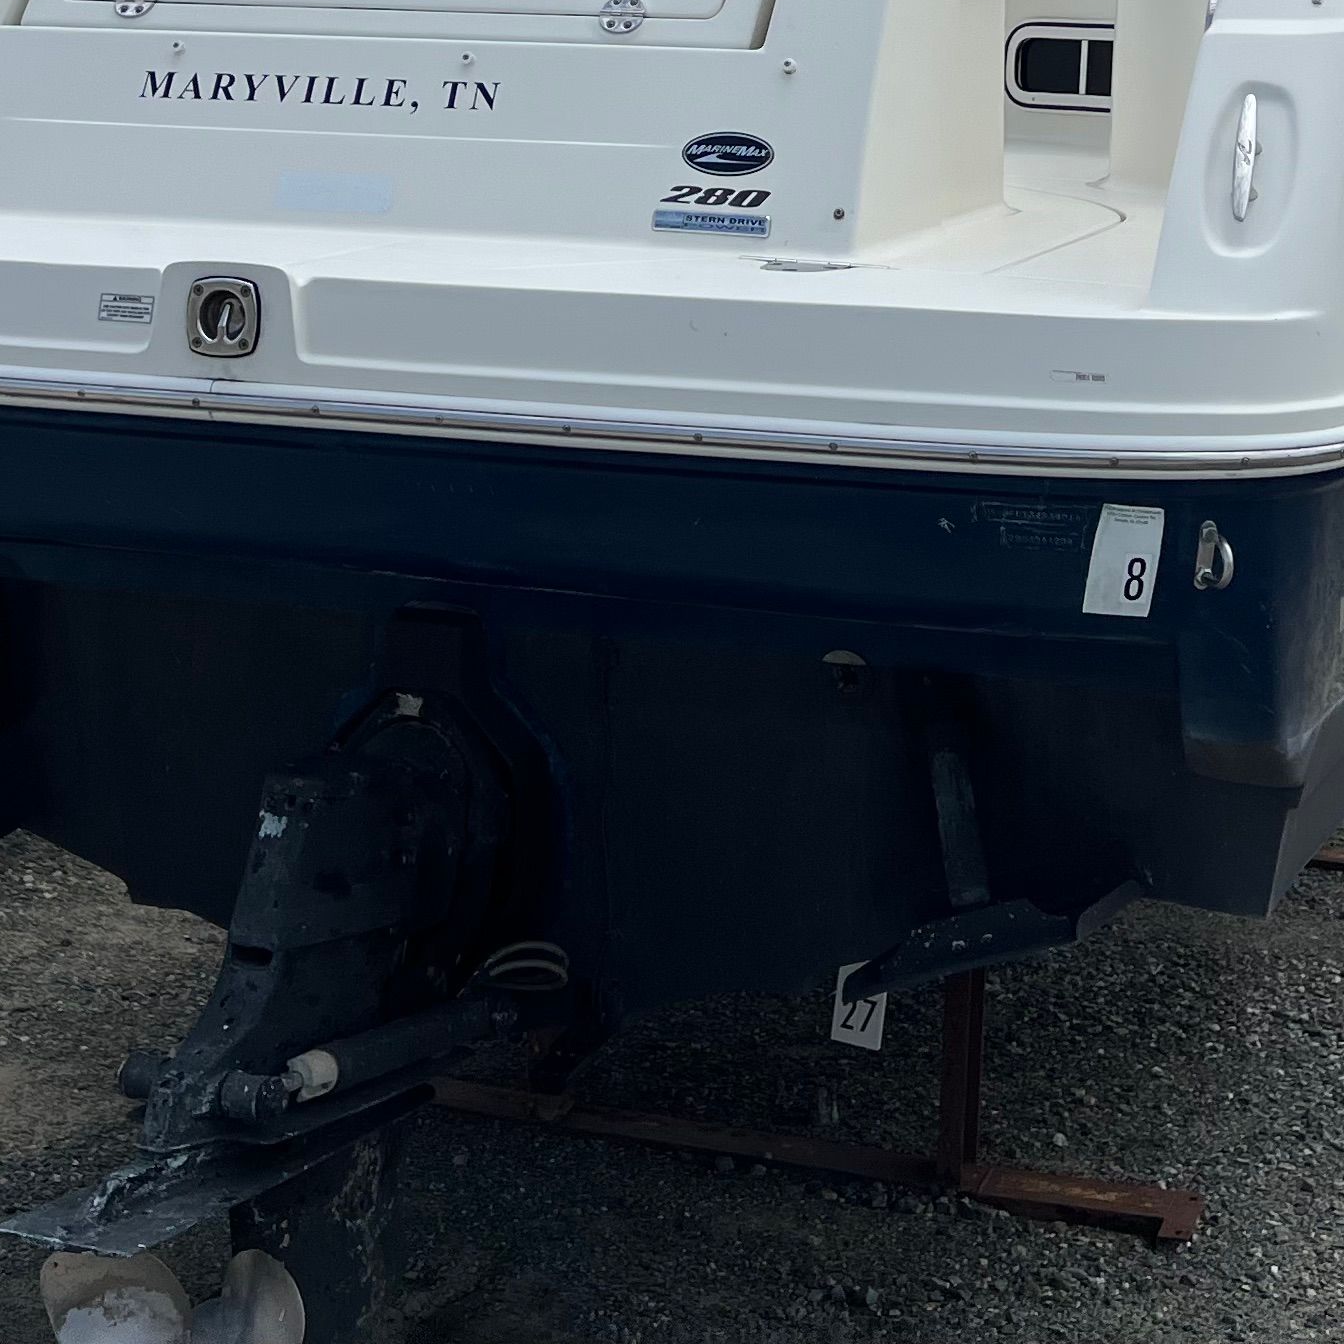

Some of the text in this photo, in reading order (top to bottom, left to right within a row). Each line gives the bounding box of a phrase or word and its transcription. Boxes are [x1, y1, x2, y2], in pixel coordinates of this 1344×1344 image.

[138, 69, 502, 115] MARYVILLE, TN
[659, 185, 772, 208] 280
[685, 214, 767, 226] STERN DRIVE
[1123, 557, 1147, 601] 8
